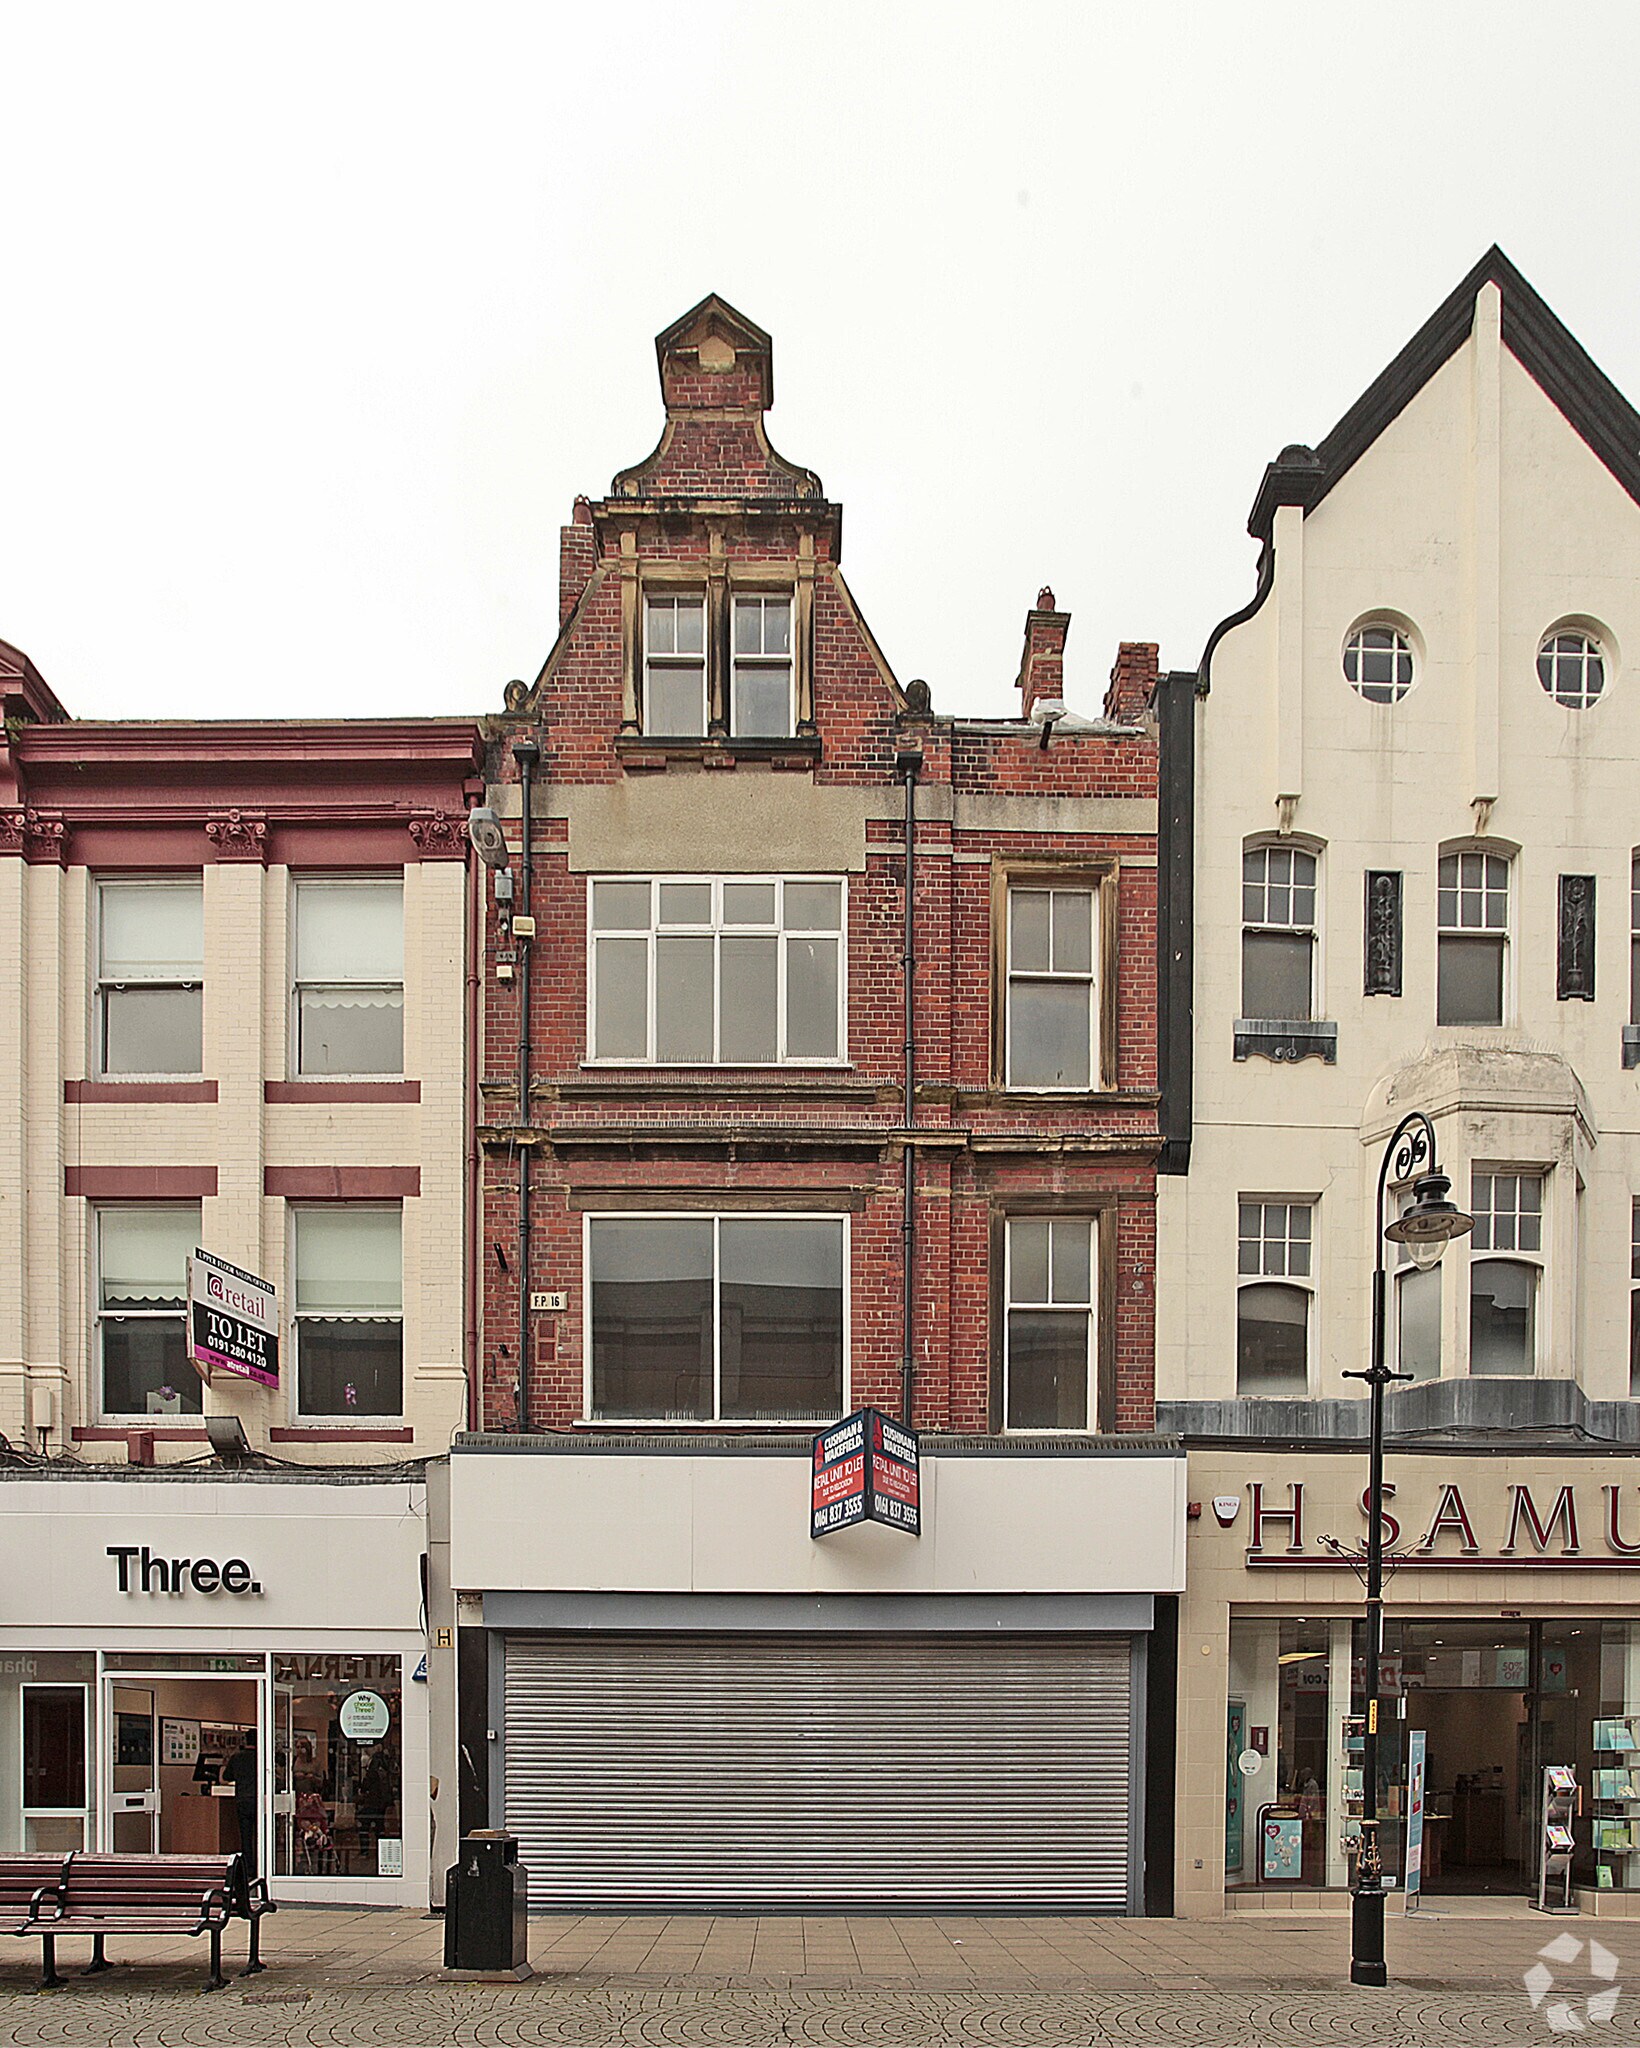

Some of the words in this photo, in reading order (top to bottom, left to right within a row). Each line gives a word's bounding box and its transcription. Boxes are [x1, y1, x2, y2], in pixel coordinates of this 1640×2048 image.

[551, 1295, 560, 1307] 16
[207, 1311, 233, 1339] TO
[236, 1323, 267, 1353] LET
[207, 1334, 229, 1353] 0191
[230, 1343, 246, 1360] 280
[246, 1351, 267, 1368] 4120
[824, 1423, 857, 1451] CUSHMAN
[857, 1420, 863, 1433] &
[882, 1424, 913, 1450] CUSHMAN
[912, 1440, 917, 1453] &
[829, 1464, 843, 1483] UNIT
[844, 1460, 853, 1475] TO
[853, 1454, 865, 1472] LET
[889, 1462, 902, 1479] UNIT
[902, 1468, 910, 1483] TO
[910, 1473, 918, 1487] LET
[814, 1508, 828, 1529] 0161
[829, 1501, 843, 1523] 837
[844, 1494, 863, 1518] 3555
[874, 1494, 889, 1515] 0161
[889, 1499, 902, 1519] 837
[902, 1504, 918, 1526] 3555
[1246, 1482, 1304, 1552] H
[437, 1628, 451, 1647] H
[1502, 1661, 1524, 1672] 50%
[1504, 1671, 1522, 1681] OFF
[357, 1694, 372, 1703] Why
